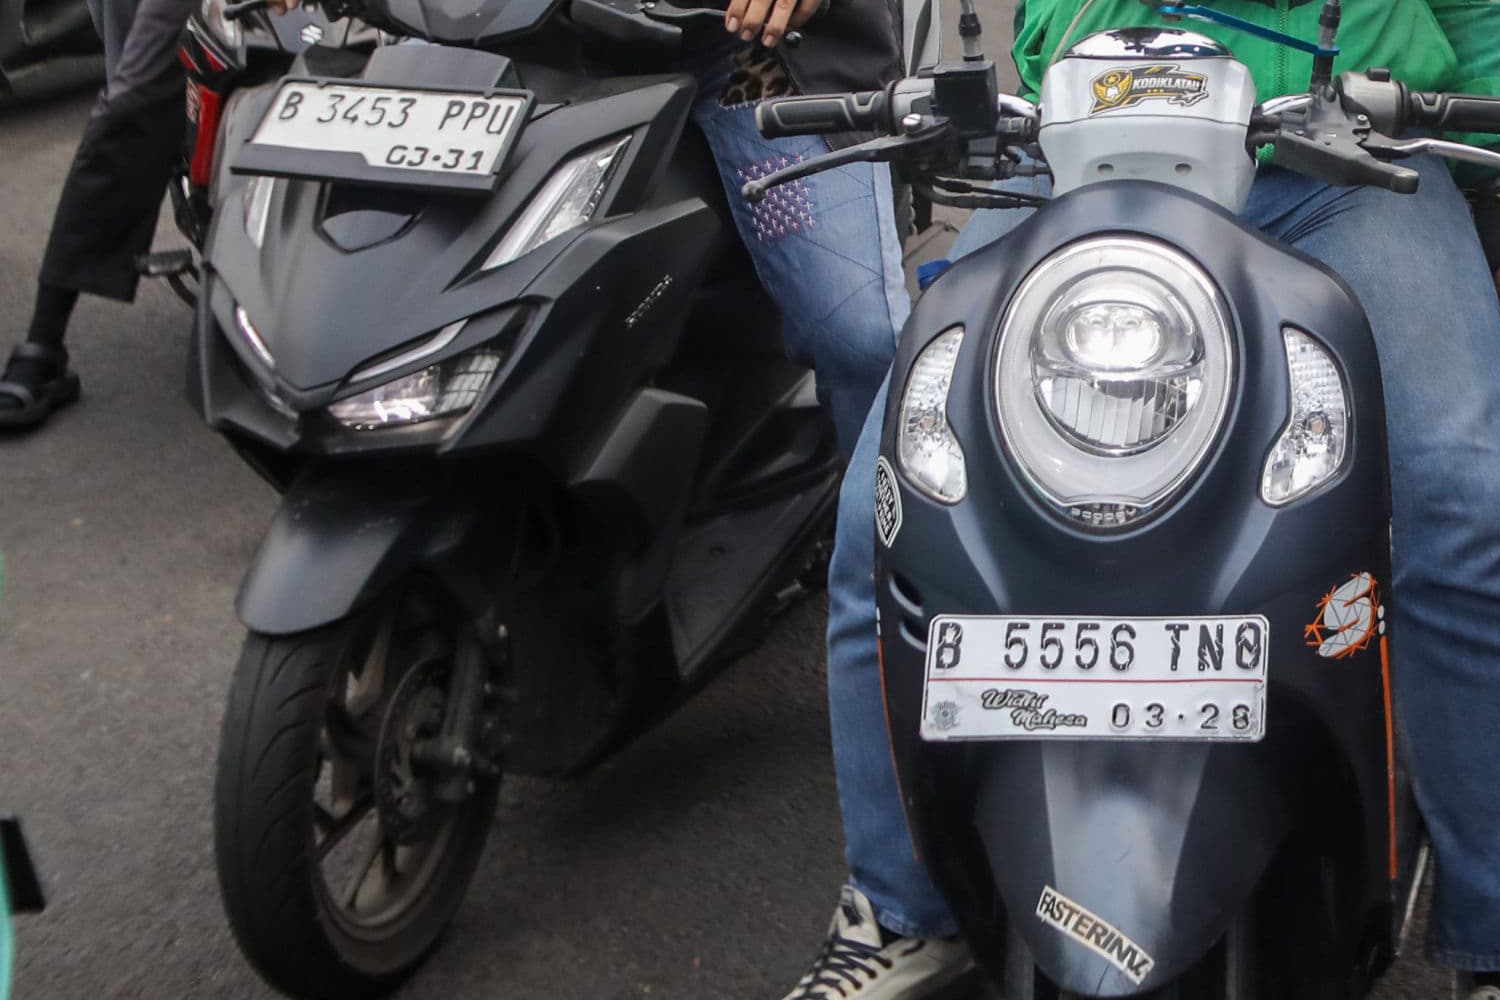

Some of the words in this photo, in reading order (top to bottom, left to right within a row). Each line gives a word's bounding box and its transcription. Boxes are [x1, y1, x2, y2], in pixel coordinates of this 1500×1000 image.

[278, 91, 304, 121] B
[317, 94, 417, 128] 3453
[438, 100, 514, 135] PPU
[935, 622, 963, 669] B
[1003, 623, 1137, 671] 5556
